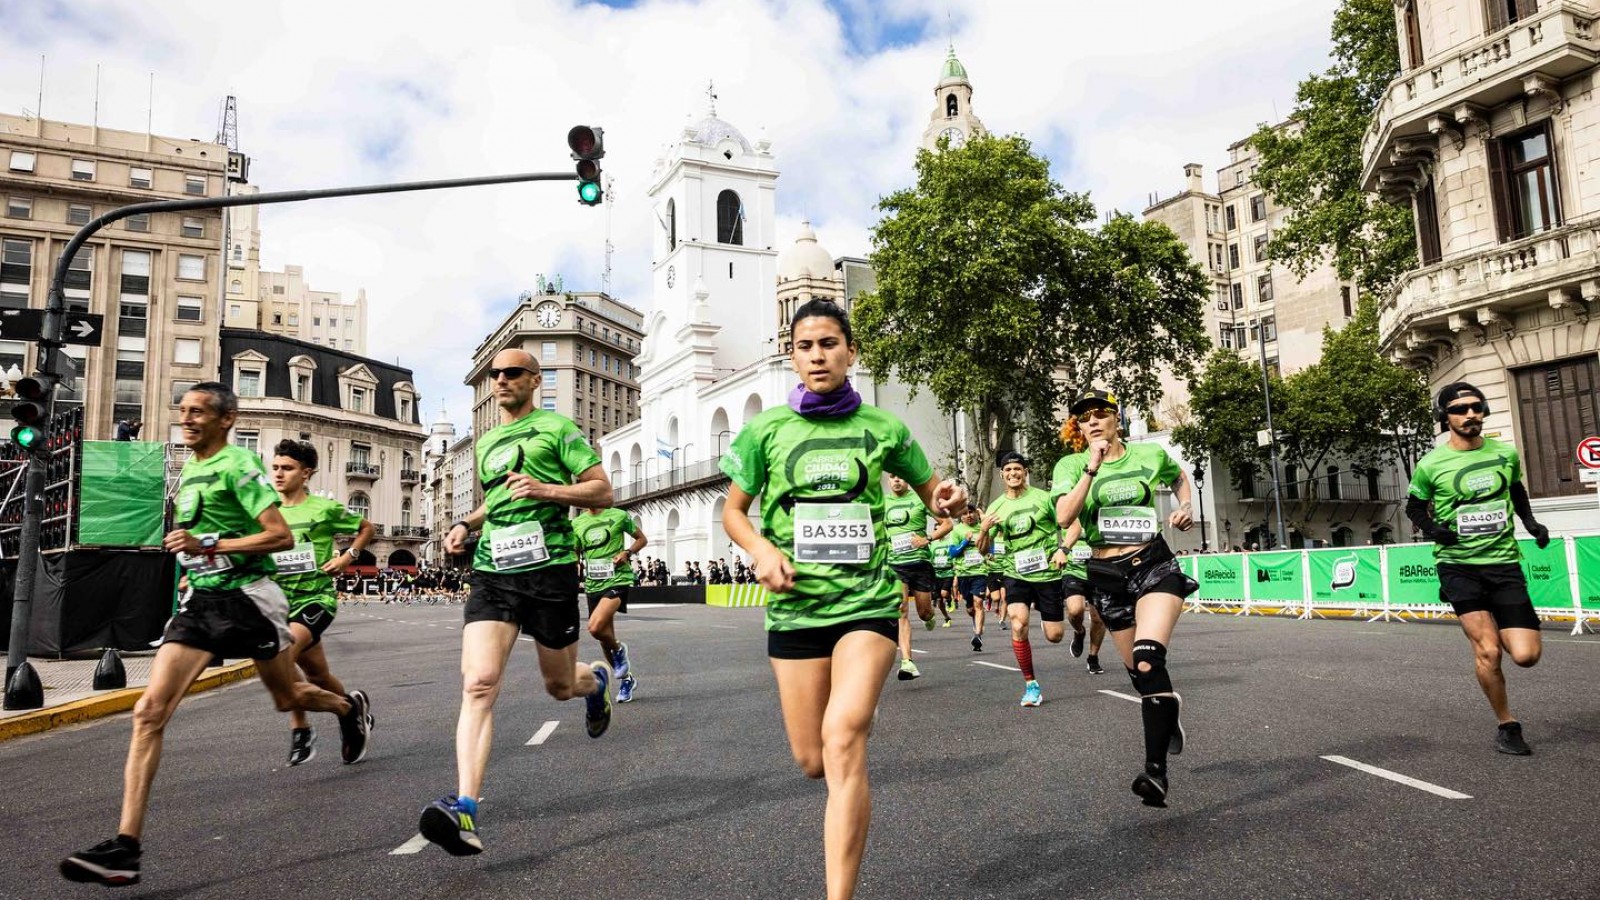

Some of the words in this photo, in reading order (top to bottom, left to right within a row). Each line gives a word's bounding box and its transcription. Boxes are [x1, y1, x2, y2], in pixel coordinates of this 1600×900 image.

[804, 462, 850, 473] CIUDAD
[804, 472, 849, 483] VERDE
[1106, 484, 1138, 495] CIUDAD
[1106, 491, 1138, 502] VERDE
[1461, 511, 1504, 523] BA4070
[1103, 519, 1151, 529] BA4730
[802, 524, 868, 539] BA3353
[496, 534, 539, 553] BA4947
[276, 551, 311, 564] BA3456
[1257, 569, 1270, 582] BA
[1399, 565, 1438, 577] #BAReci
[1532, 572, 1550, 580] Verde
